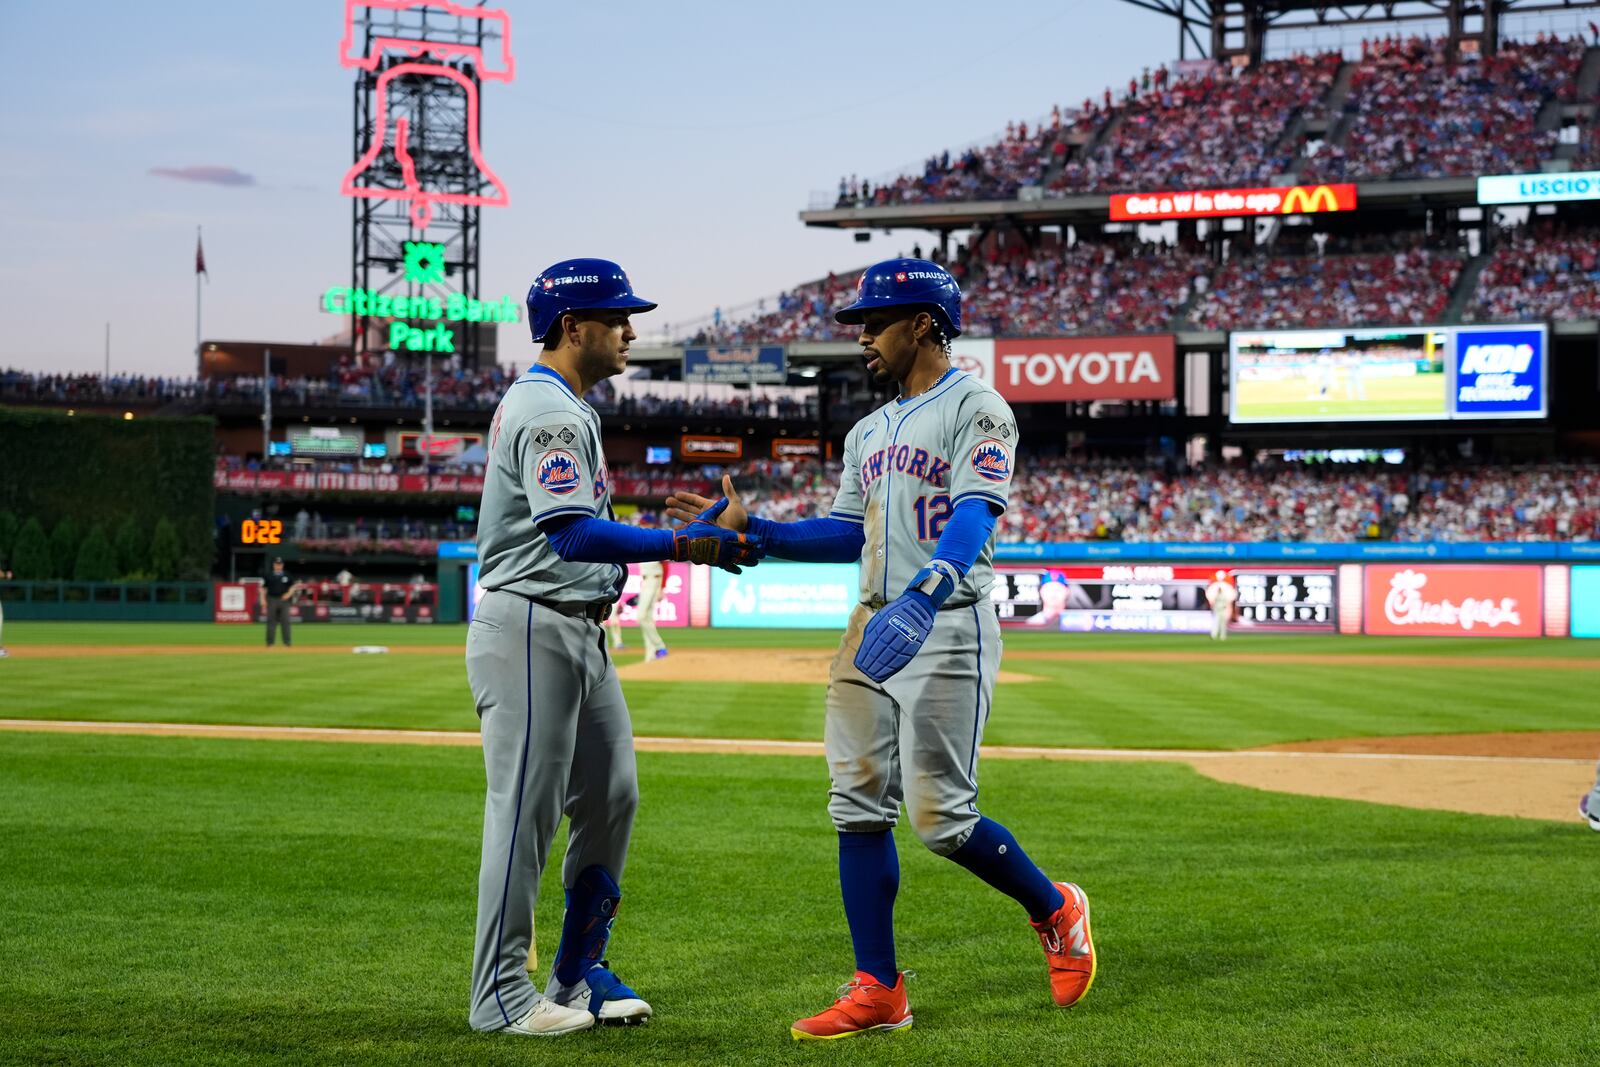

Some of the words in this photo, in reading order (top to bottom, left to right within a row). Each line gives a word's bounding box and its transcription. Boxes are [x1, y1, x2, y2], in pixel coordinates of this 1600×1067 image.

[554, 275, 599, 286] STRAUSS
[324, 287, 444, 321] Citizens
[446, 292, 520, 323] Bank
[389, 322, 456, 353] Park
[1002, 352, 1161, 387] TOYOTA
[545, 466, 575, 483] Mets
[885, 444, 951, 489] YORK
[241, 519, 282, 544] 0:22
[913, 493, 954, 542] 12
